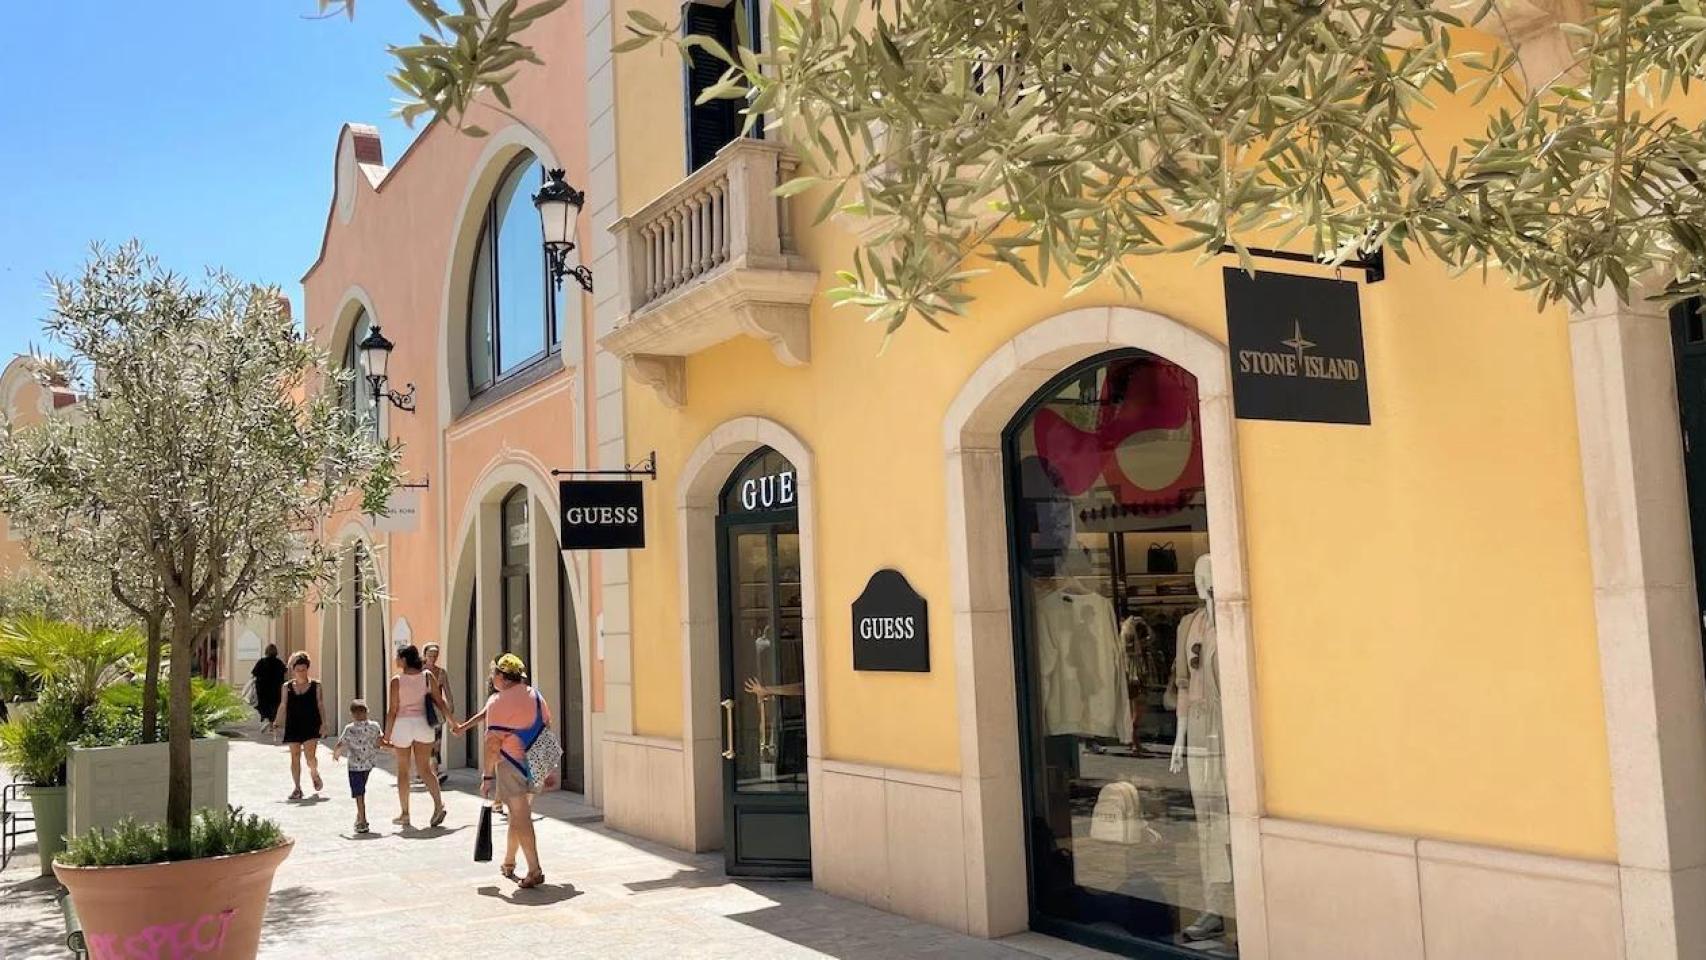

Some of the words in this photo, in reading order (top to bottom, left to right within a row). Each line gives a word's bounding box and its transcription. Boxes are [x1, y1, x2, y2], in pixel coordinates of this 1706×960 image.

[1240, 349, 1297, 377] STONE
[1304, 355, 1359, 381] ISLAND
[742, 471, 794, 511] GUE
[566, 506, 638, 525] GUESS
[860, 616, 915, 639] GUESS
